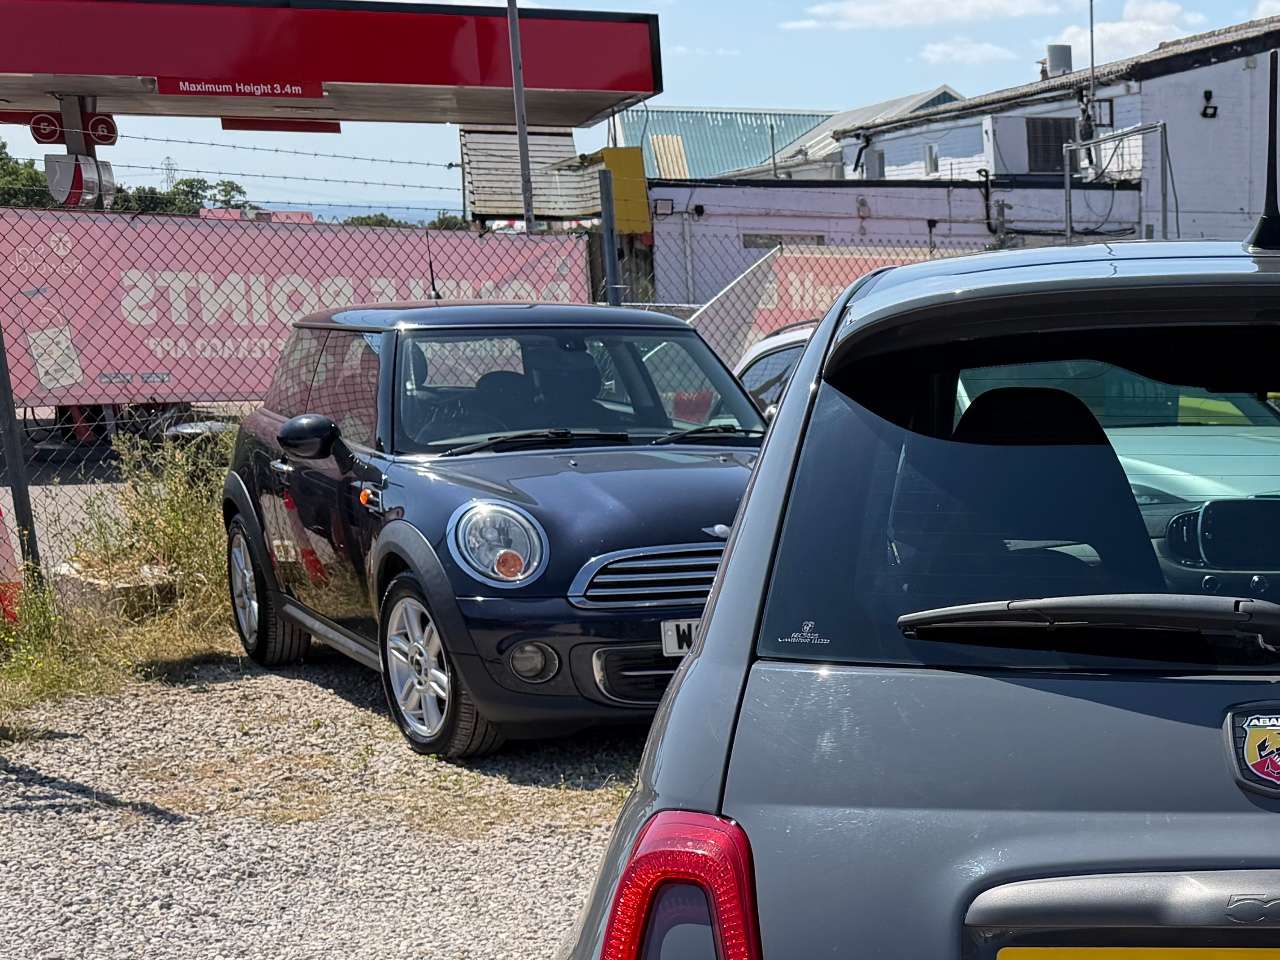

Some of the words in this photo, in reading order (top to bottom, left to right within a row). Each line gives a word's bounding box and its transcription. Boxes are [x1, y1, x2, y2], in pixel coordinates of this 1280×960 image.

[178, 81, 232, 93] Maximum
[235, 82, 272, 96] Height
[273, 84, 302, 95] 3.4m
